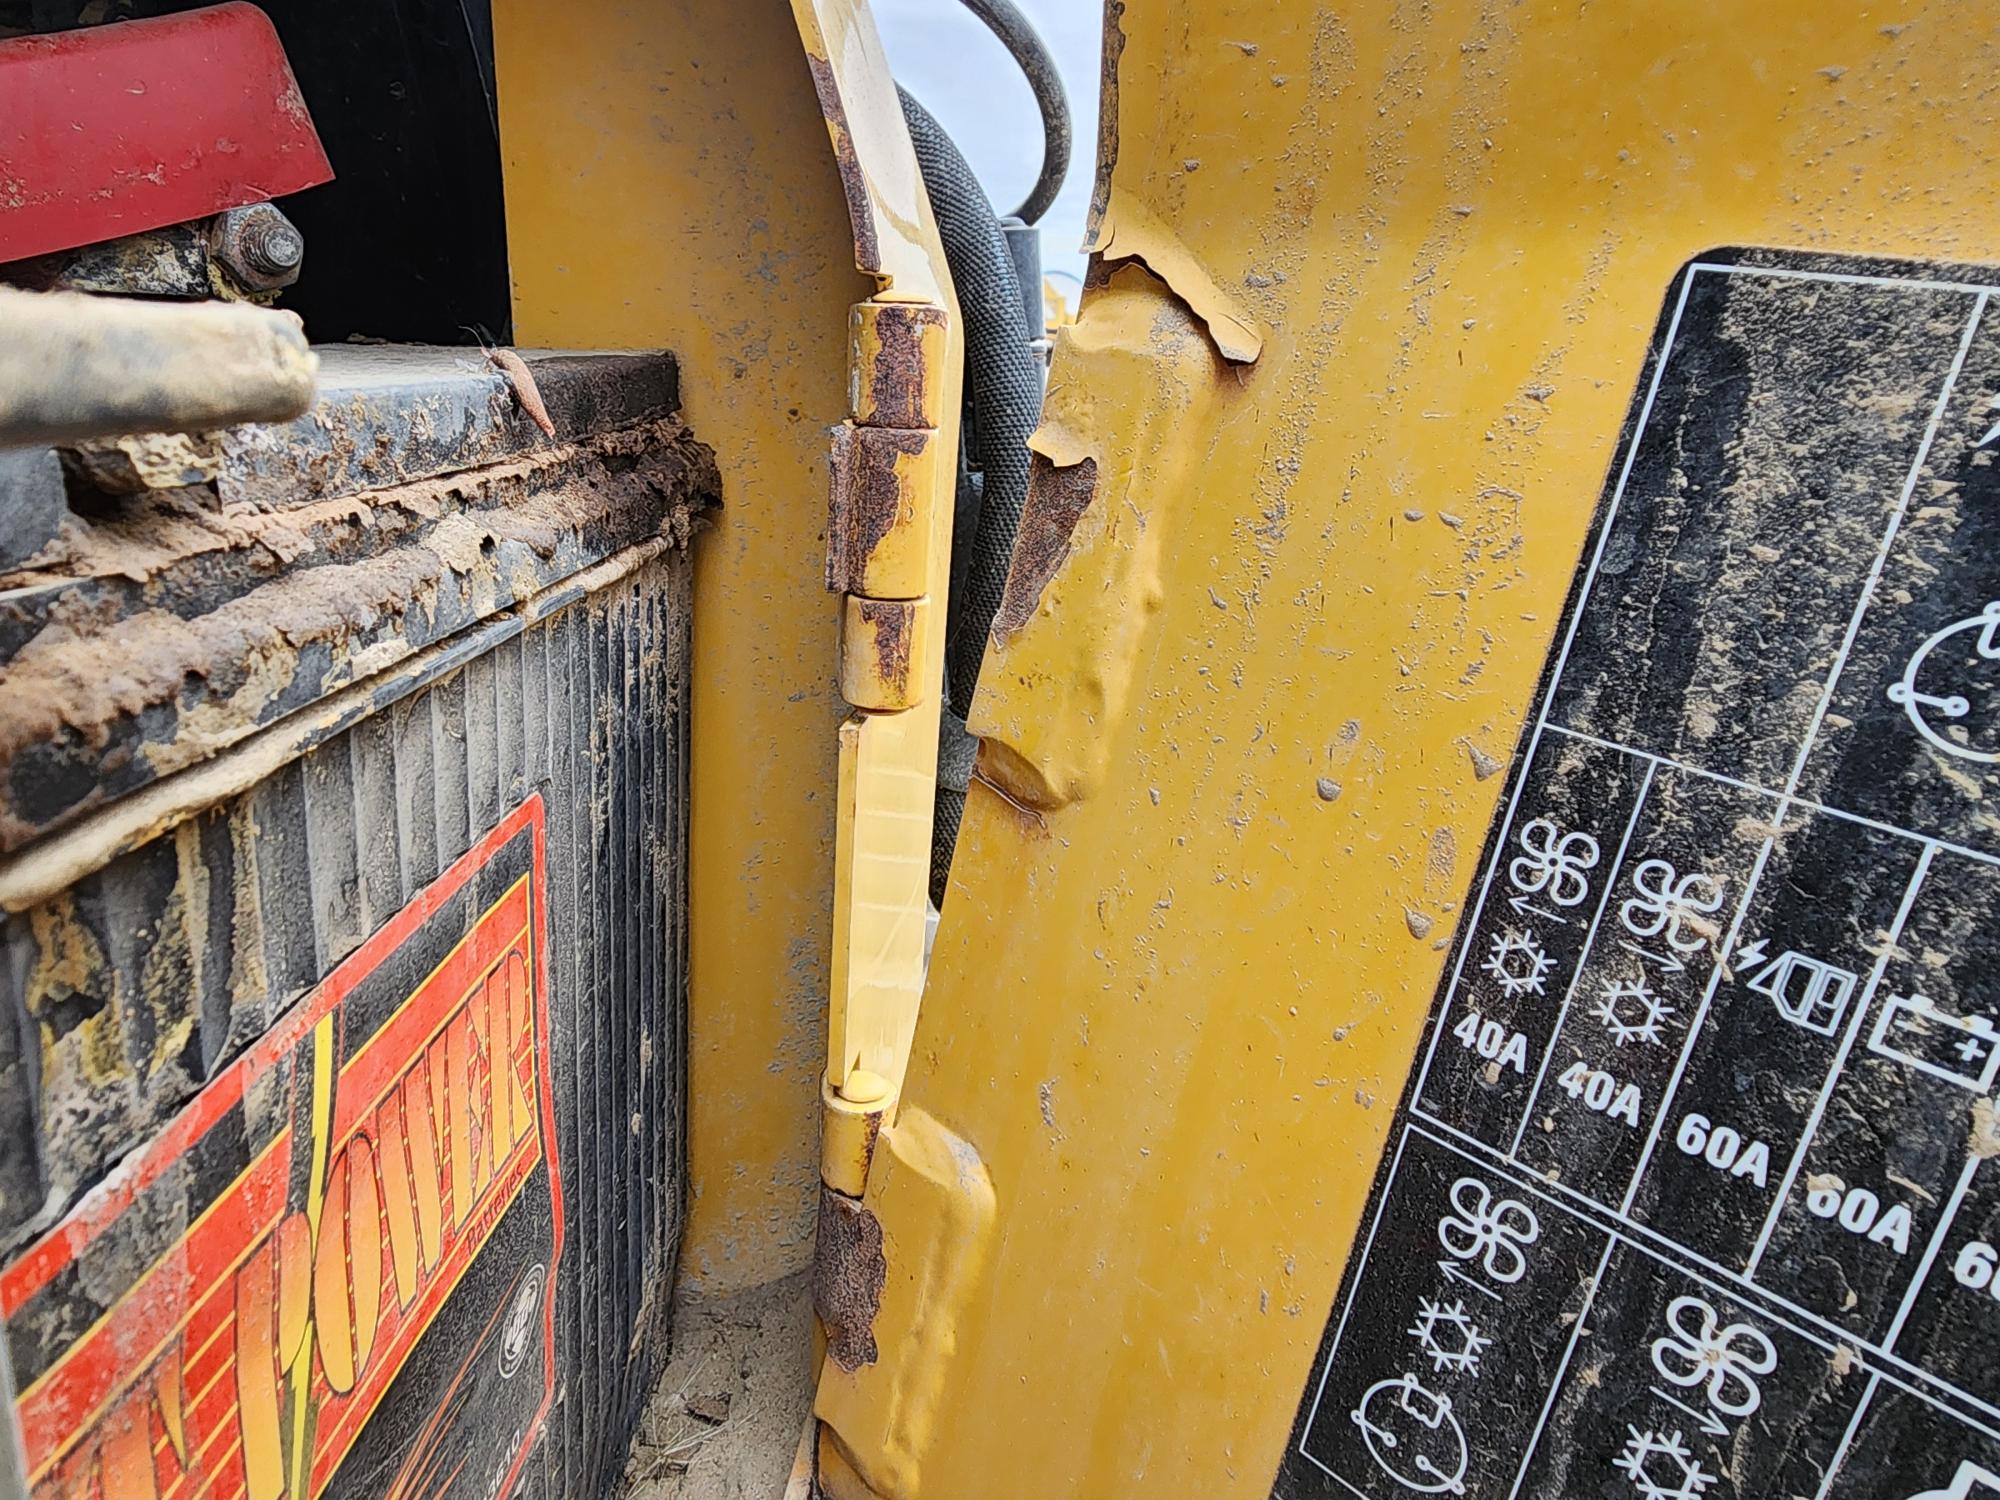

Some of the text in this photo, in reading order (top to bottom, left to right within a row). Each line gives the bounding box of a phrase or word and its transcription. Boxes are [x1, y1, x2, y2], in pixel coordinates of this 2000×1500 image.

[1453, 1013, 1527, 1073] 40A
[1558, 1061, 1642, 1128] 40A
[1675, 1112, 1770, 1188] 60A
[234, 949, 533, 1500] POWER
[466, 1163, 524, 1256] Batteries
[1806, 1173, 1912, 1255] 60A
[1954, 1241, 2000, 1301] 6
